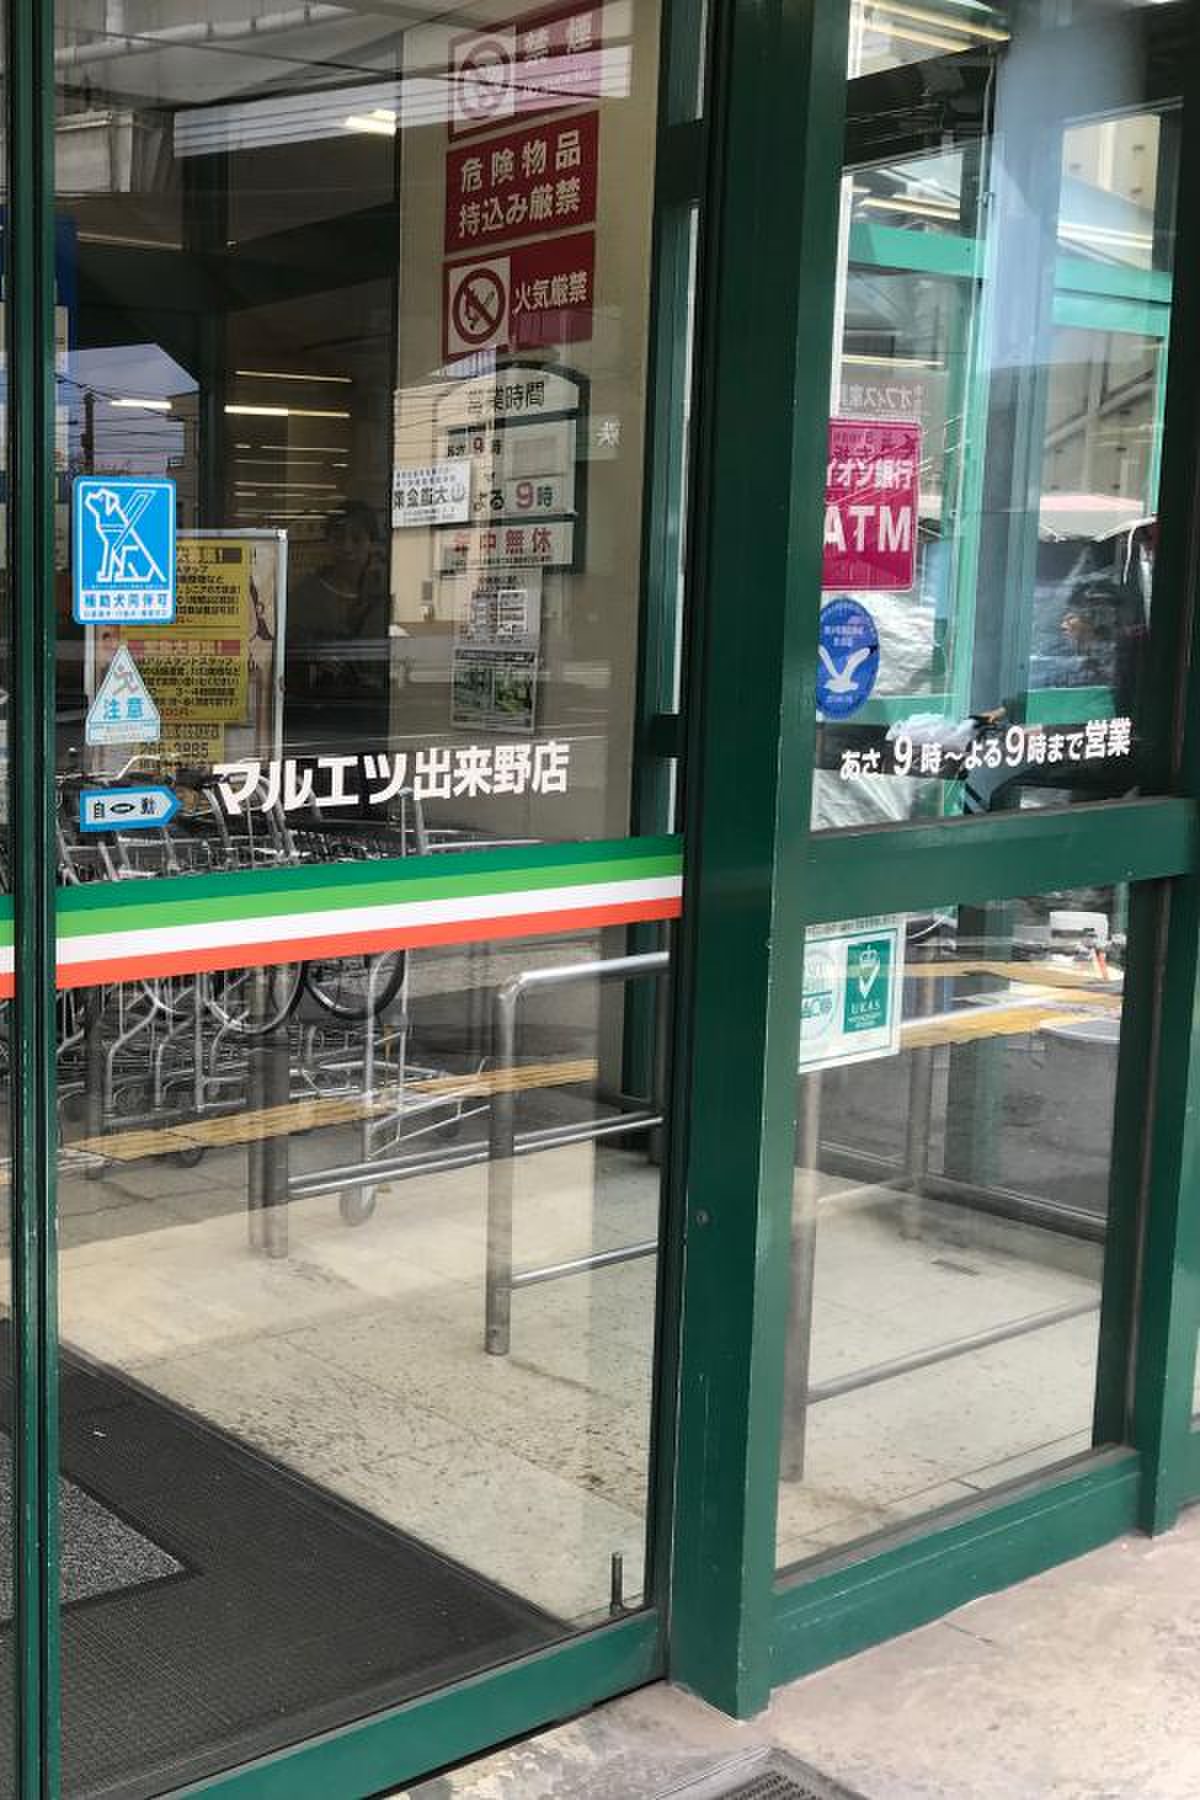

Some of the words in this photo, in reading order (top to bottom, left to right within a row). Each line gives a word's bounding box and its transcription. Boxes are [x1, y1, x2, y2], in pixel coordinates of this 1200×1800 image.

[460, 128, 582, 193] 危険物品
[458, 177, 582, 238] 持込み厳禁
[512, 271, 589, 315] 火気厳禁
[823, 504, 911, 552] ATM
[103, 696, 144, 720] 注意
[212, 741, 570, 815] マルエツ出来野店
